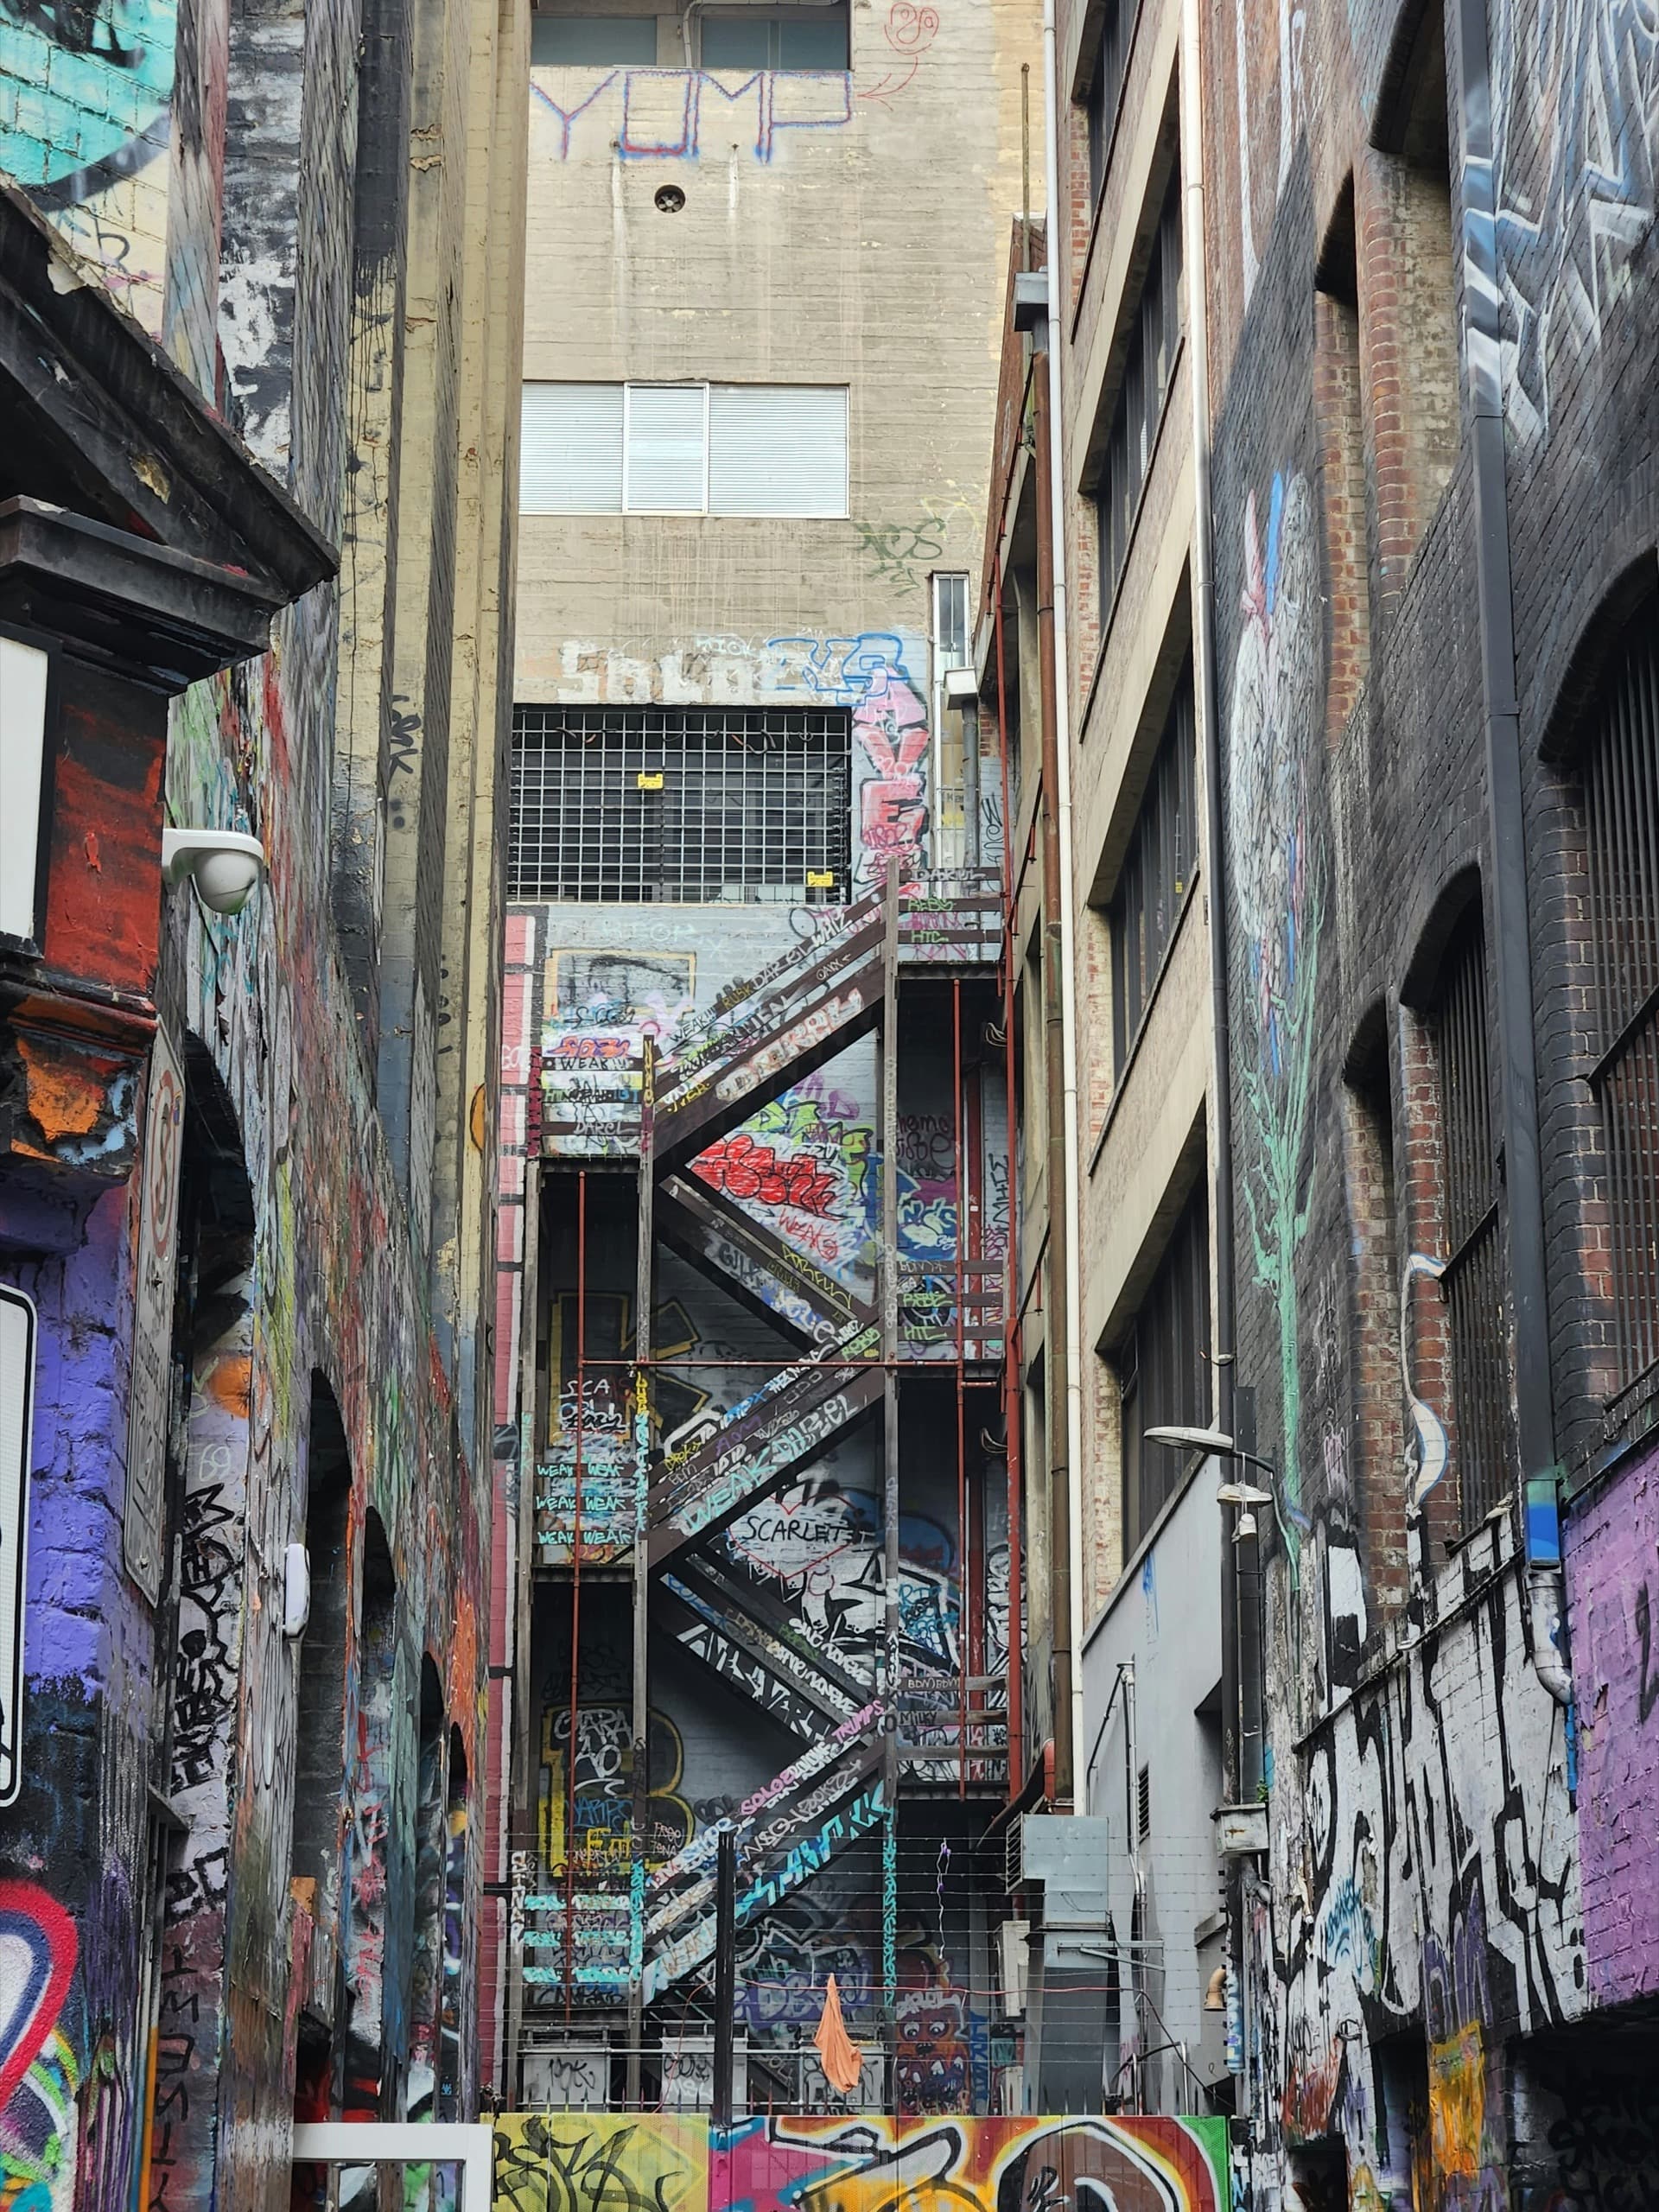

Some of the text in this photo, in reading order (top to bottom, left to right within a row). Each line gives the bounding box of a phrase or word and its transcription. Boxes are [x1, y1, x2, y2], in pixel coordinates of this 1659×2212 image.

[588, 1463, 625, 1478] WEAK
[680, 1446, 778, 1533] WEAK
[585, 1496, 626, 1511] WEAK
[583, 1529, 632, 1546] WEAK
[742, 1516, 845, 1542] SCARLET
[831, 1700, 885, 1743] TRUMPS
